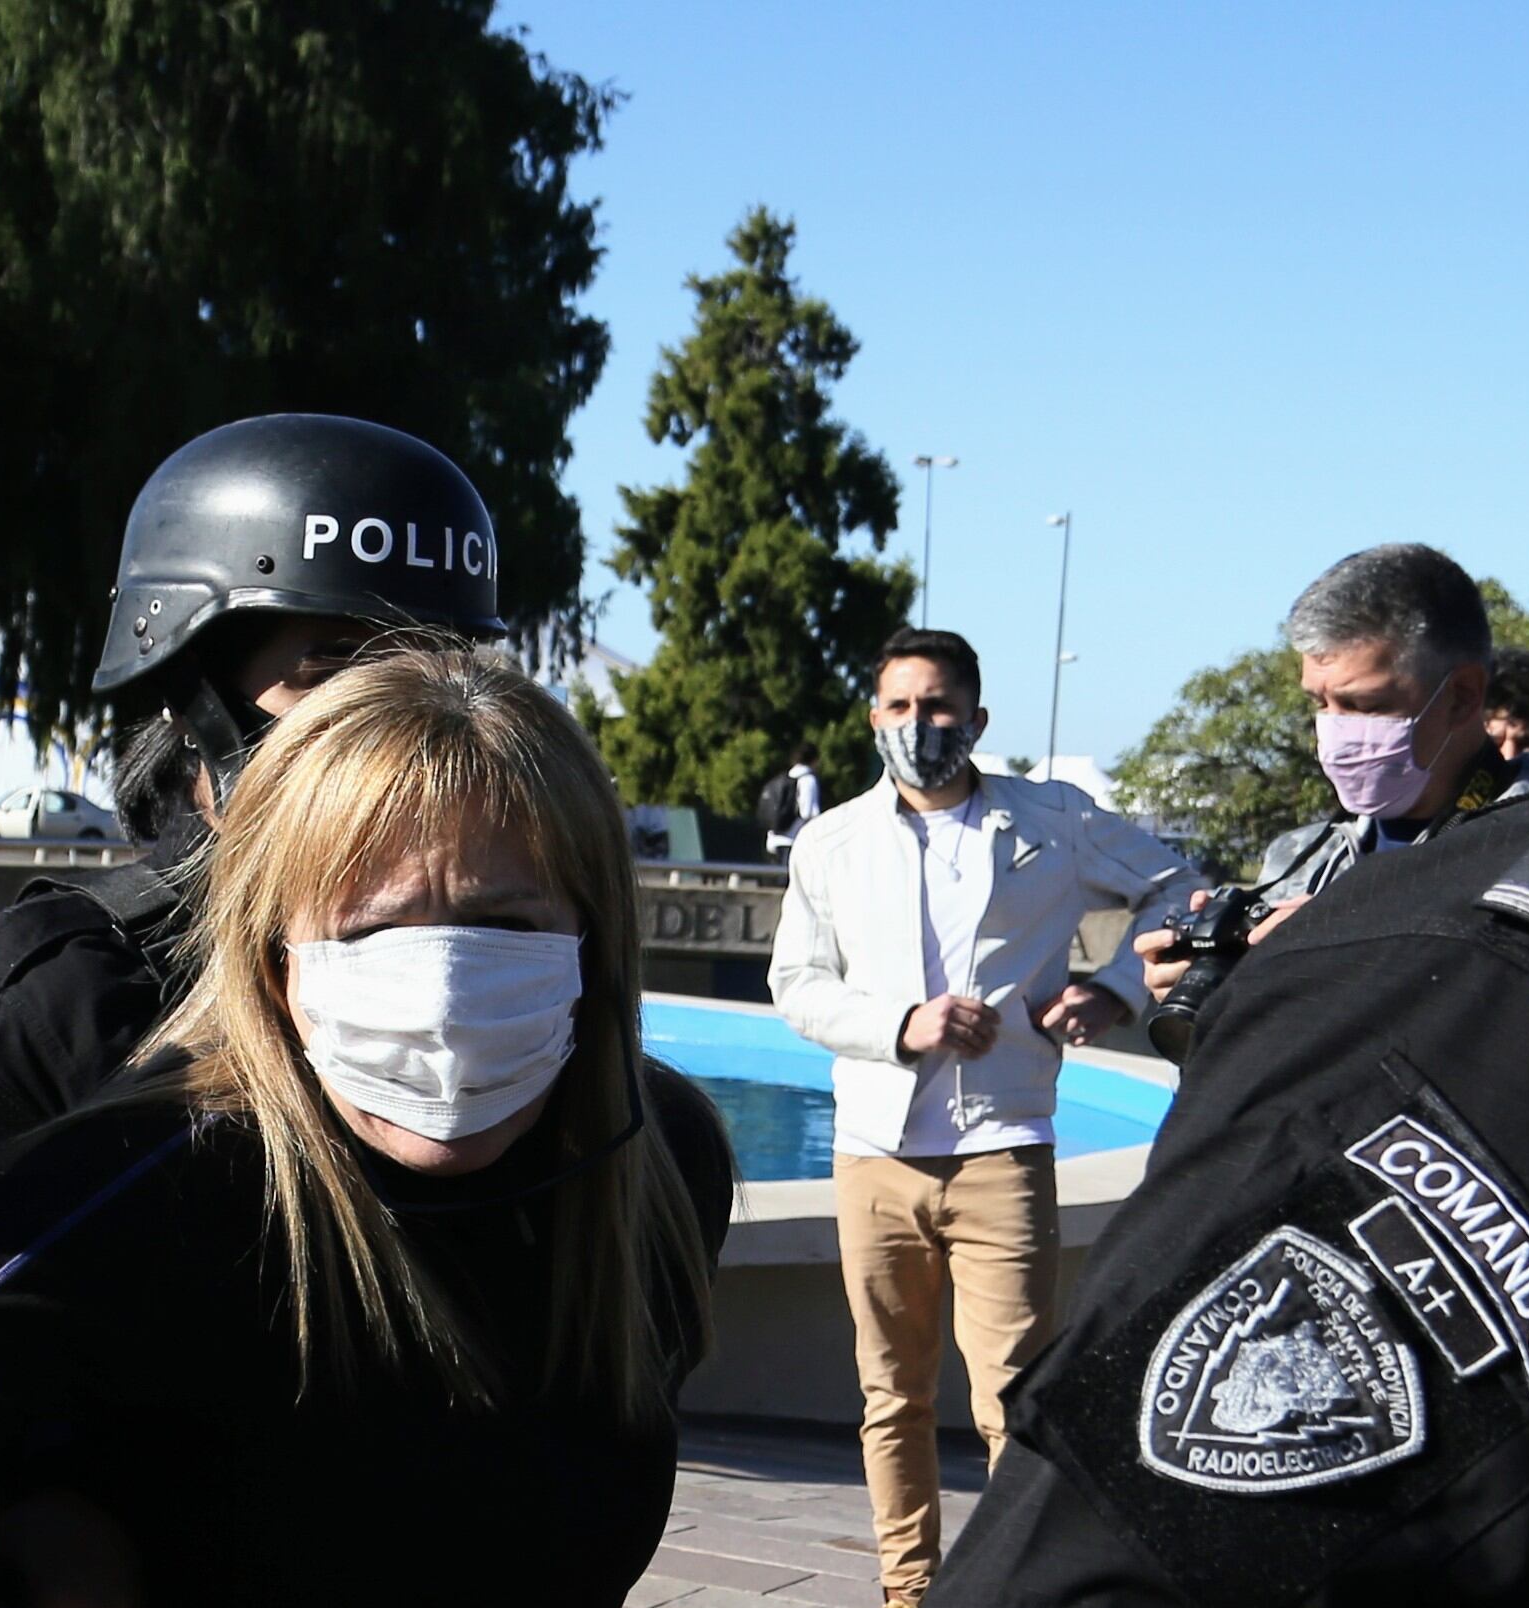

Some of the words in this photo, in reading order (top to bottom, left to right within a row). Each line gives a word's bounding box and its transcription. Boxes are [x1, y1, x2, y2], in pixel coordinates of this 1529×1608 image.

[303, 514, 497, 582] POLICI
[653, 902, 722, 942] DE
[1393, 1257, 1455, 1317] A+
[1156, 1278, 1263, 1416] COMANDO
[1282, 1245, 1347, 1299] POLICIA
[1373, 1341, 1411, 1438] PROVINCIA
[1306, 1282, 1331, 1311] DE
[1328, 1310, 1372, 1377] SANTA
[1366, 1376, 1388, 1404] FE
[1186, 1432, 1368, 1477] RADIOELECTRICO
